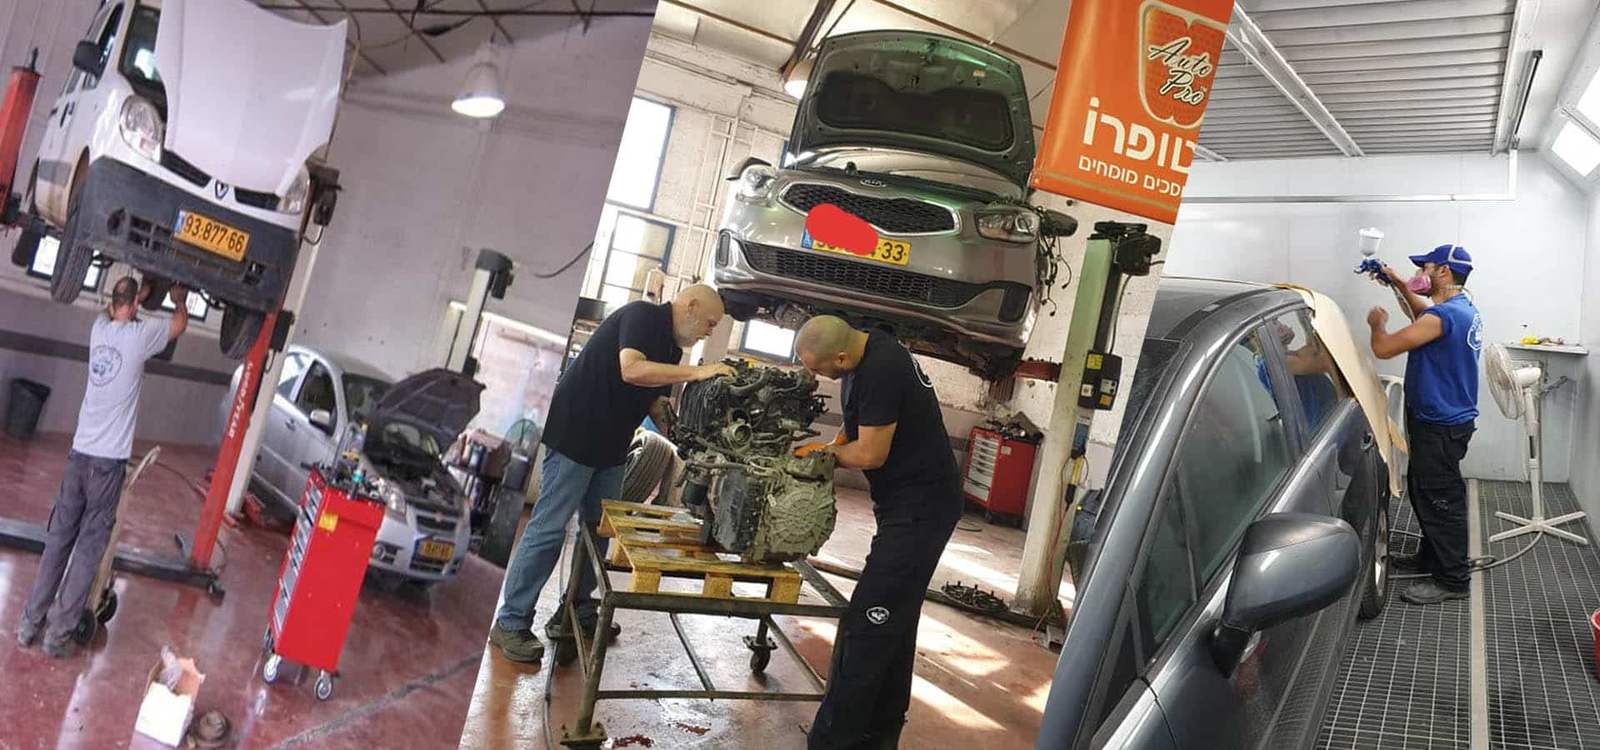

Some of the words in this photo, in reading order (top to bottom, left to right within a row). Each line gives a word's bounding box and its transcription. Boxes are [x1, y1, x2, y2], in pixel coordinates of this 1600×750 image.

[1146, 36, 1213, 78] Auto
[1160, 69, 1206, 105] Pro
[1078, 156, 1139, 185] מומחים
